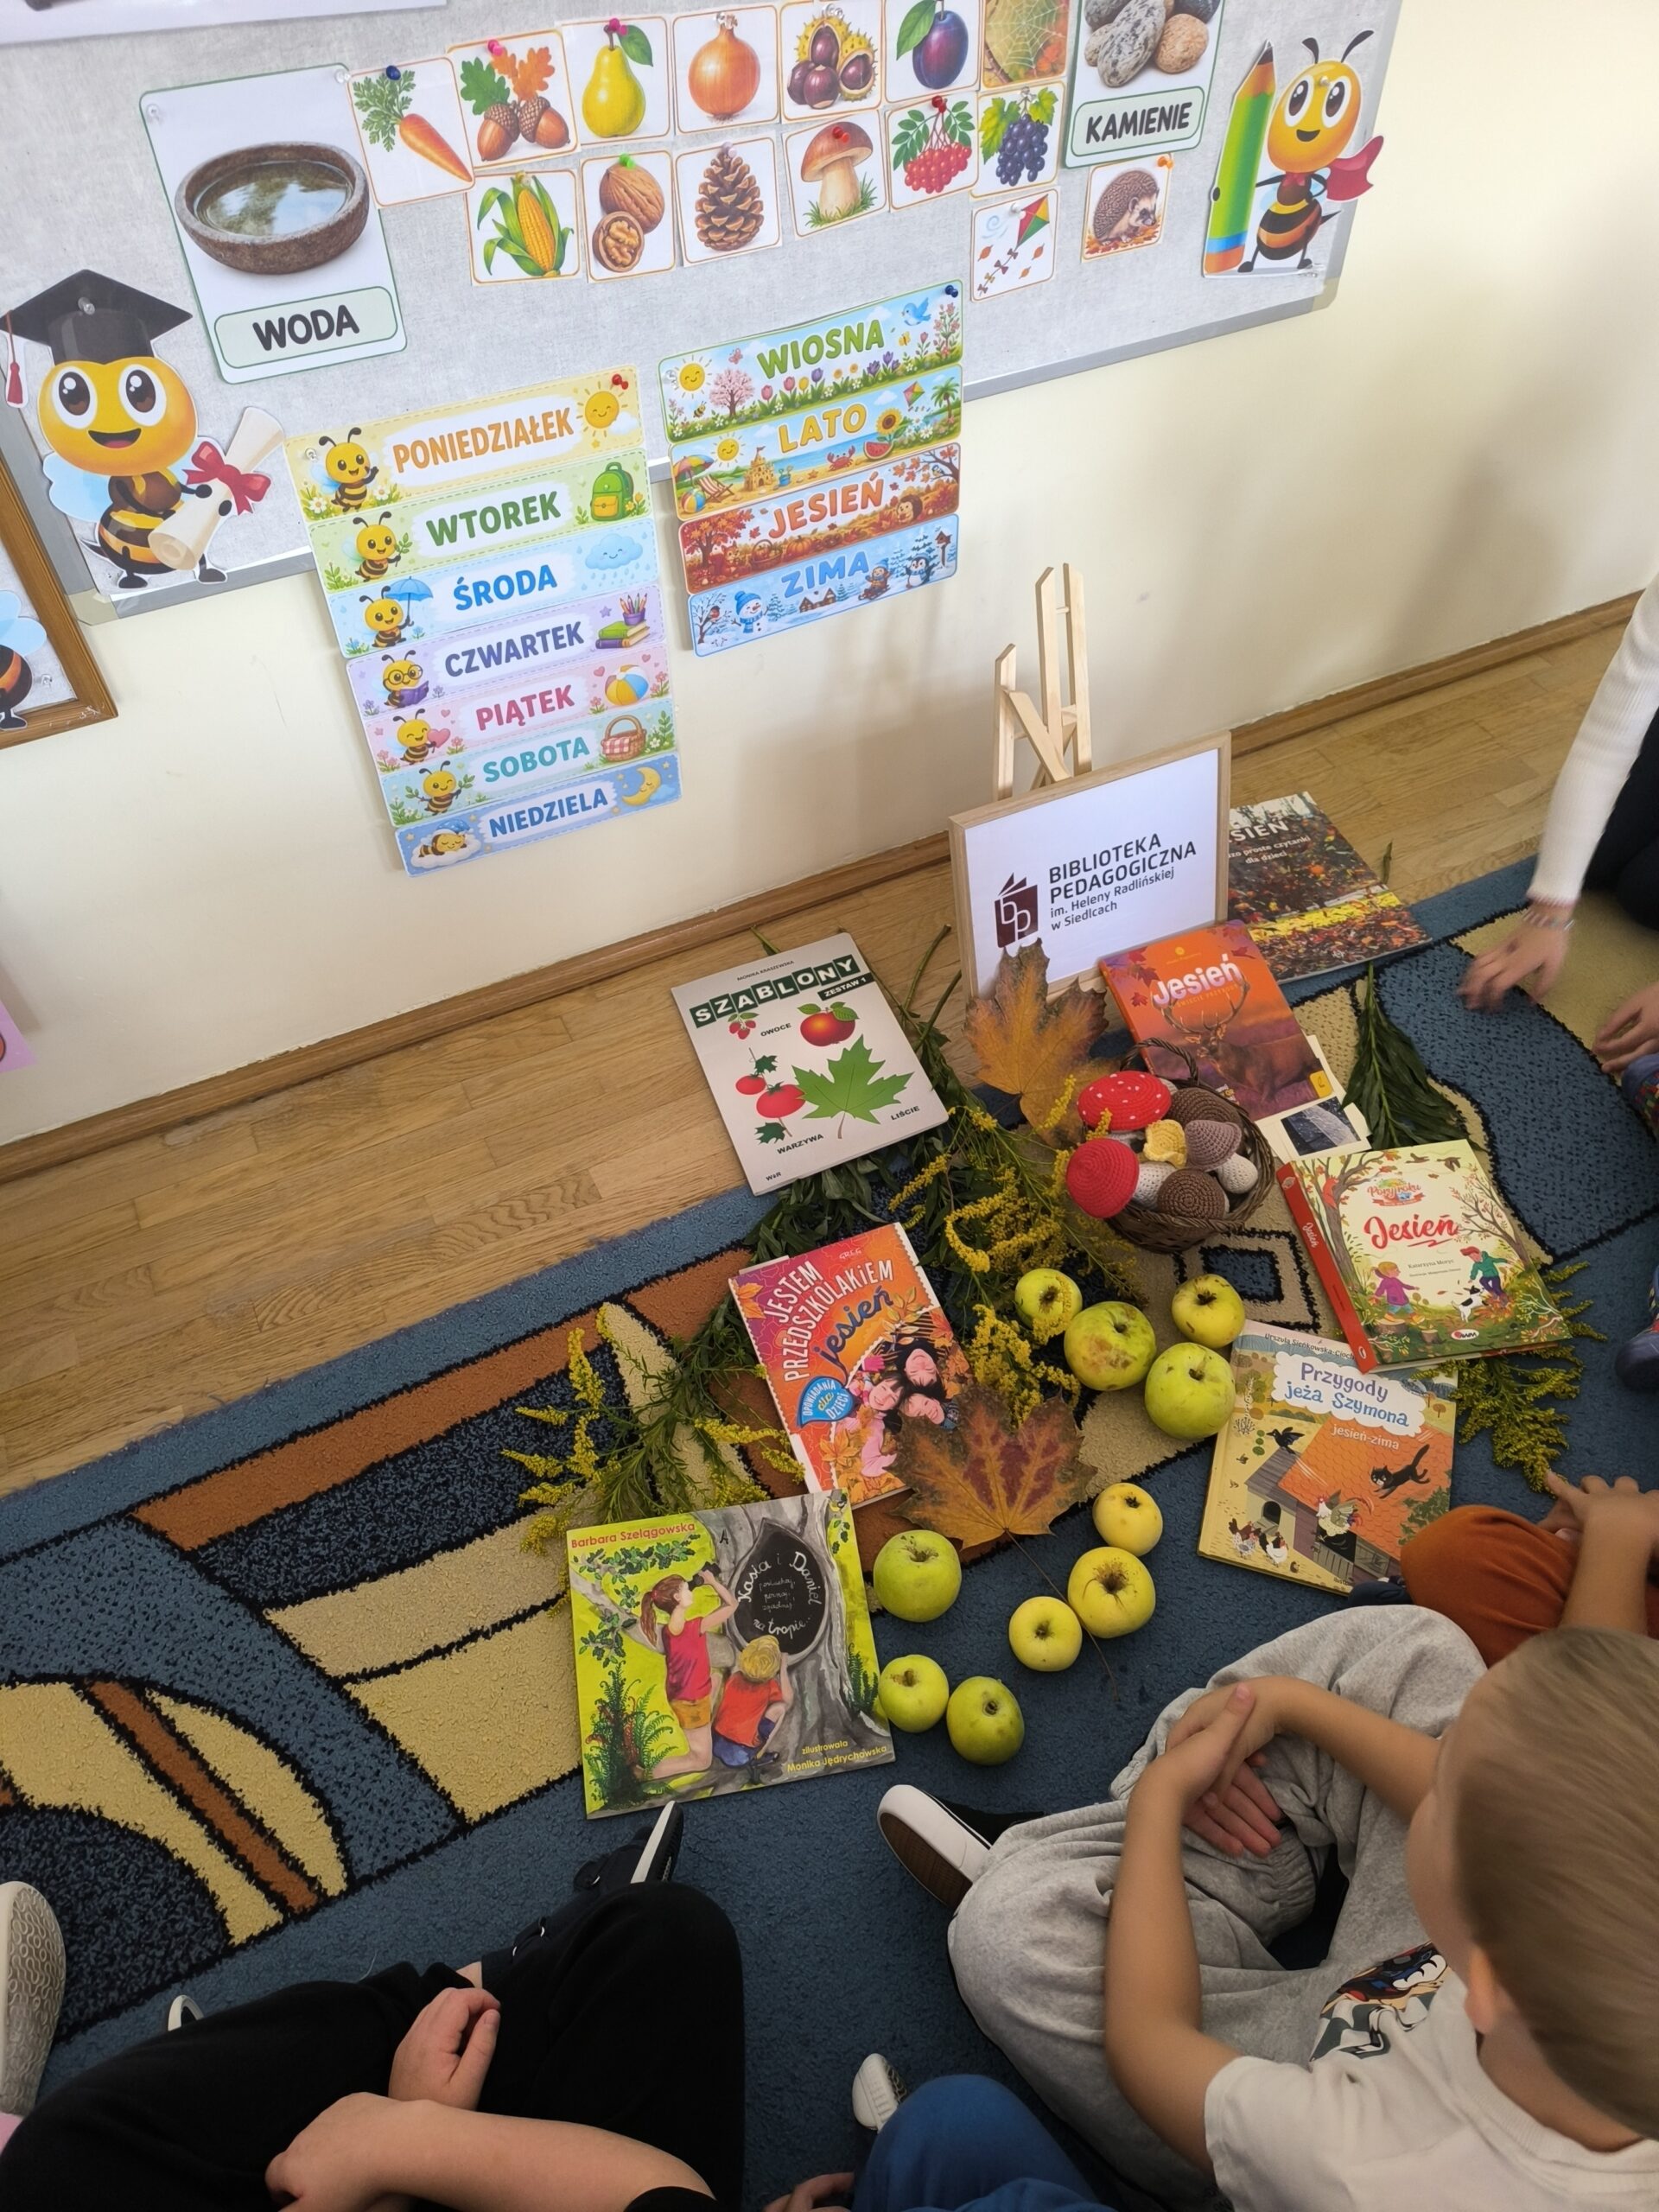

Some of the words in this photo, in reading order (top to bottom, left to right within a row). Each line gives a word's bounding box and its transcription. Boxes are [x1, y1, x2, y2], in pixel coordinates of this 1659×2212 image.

[1085, 102, 1192, 143] KAMIENIE
[252, 306, 359, 352] WODA
[756, 320, 885, 380] WIOSNA
[392, 407, 574, 473] PONIEDZIAŁEK
[777, 403, 868, 454] LATO
[425, 491, 562, 547] WTOREK
[768, 471, 884, 540] JESIEŃ
[454, 564, 557, 610] ŚRODA
[782, 551, 869, 597] ZIMA
[444, 621, 584, 677] CZWARTEK
[475, 684, 575, 731] PIĄTEK
[483, 737, 589, 783] SOBOTA
[488, 788, 608, 837] NIEDZIELA
[1228, 817, 1289, 843] SIEŃ
[1049, 833, 1162, 884] BIBLIOTEKA
[1243, 845, 1272, 855] proste
[1274, 836, 1311, 848] czytanki
[1262, 850, 1287, 862] dzieci
[1050, 841, 1197, 904] PEDAGOGICZNA
[1051, 907, 1068, 918] im.
[1071, 891, 1111, 912] Heleny
[1114, 867, 1175, 897] Radlińskiej
[1051, 920, 1061, 931] w
[1064, 901, 1117, 927] Siedlcach
[695, 958, 853, 1022] SZABLONY
[736, 970, 760, 982] MONIKA
[824, 980, 860, 997] ZESTAW
[1153, 953, 1243, 1008] Jesień
[760, 1023, 791, 1037] OWOCE
[891, 1105, 920, 1121] LIŚCIE
[777, 1134, 824, 1154] WARZYWA
[1364, 1214, 1460, 1249] Jesień
[764, 1261, 823, 1323] JESTEM
[812, 1286, 893, 1383] jesień
[1265, 1333, 1291, 1345] Urszula
[818, 1392, 834, 1410] dla
[1285, 1381, 1323, 1402] jeża
[1332, 1392, 1409, 1427] Szymona
[1301, 1363, 1388, 1402] Przygody
[1332, 1424, 1399, 1449] jesień-zima
[571, 1534, 617, 1548] Barbara
[620, 1522, 695, 1541] Szelągowska
[738, 1560, 772, 1603] Kasia
[789, 1551, 822, 1605] Daniel
[753, 1619, 766, 1631] na
[787, 1760, 820, 1772] Monika
[823, 1746, 887, 1766] Jędrychowska
